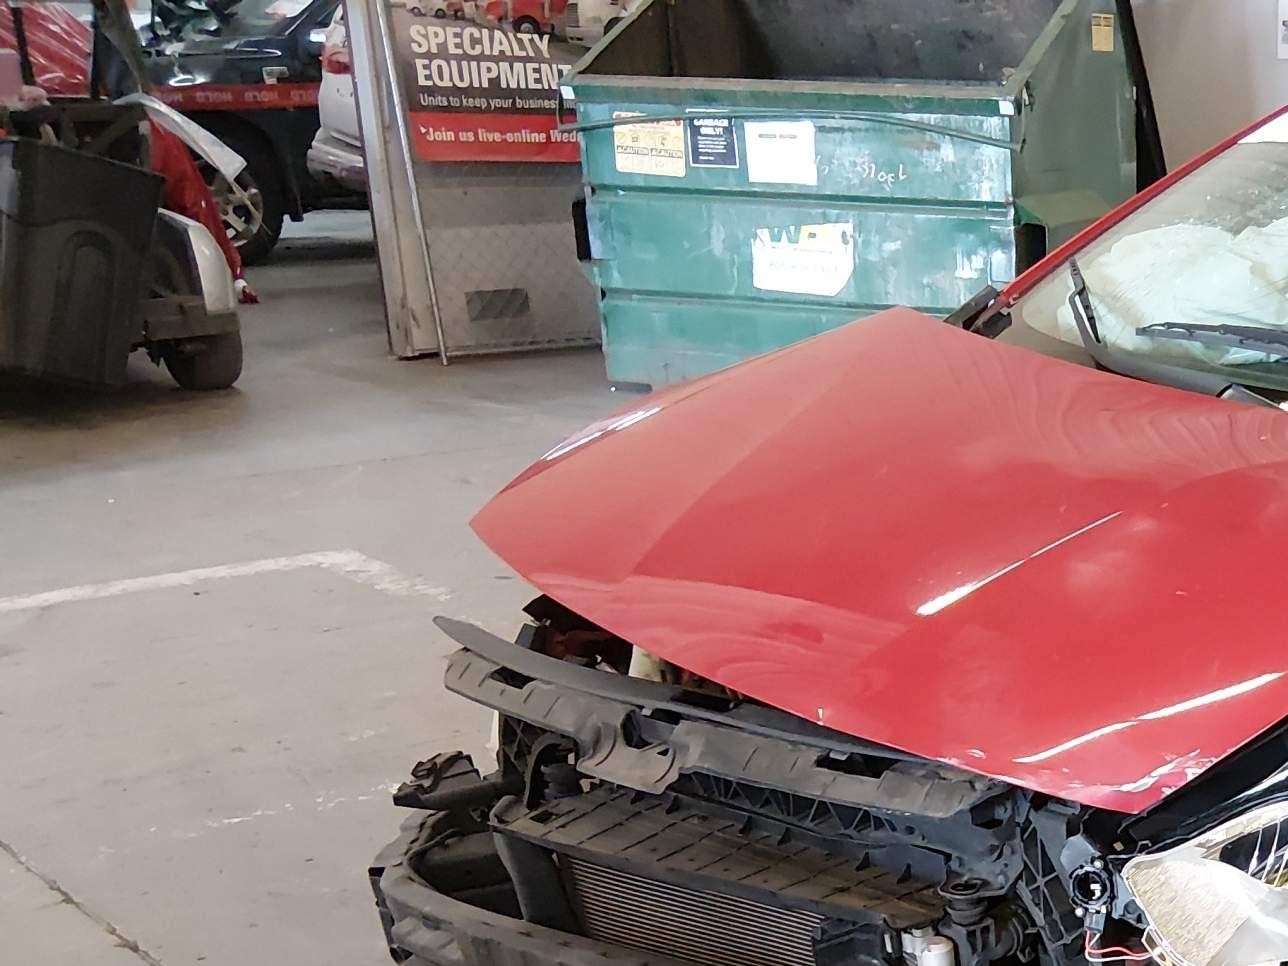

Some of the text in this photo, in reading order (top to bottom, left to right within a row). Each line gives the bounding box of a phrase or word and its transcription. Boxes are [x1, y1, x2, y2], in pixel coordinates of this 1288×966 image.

[409, 24, 550, 58] SPECIALTY
[415, 58, 573, 90] EQUIPMENT
[420, 94, 448, 107] Units
[450, 95, 460, 107] to
[462, 95, 487, 110] keep
[489, 97, 512, 111] your
[426, 127, 455, 142] Join
[459, 129, 474, 142] us
[478, 127, 546, 143] live-online
